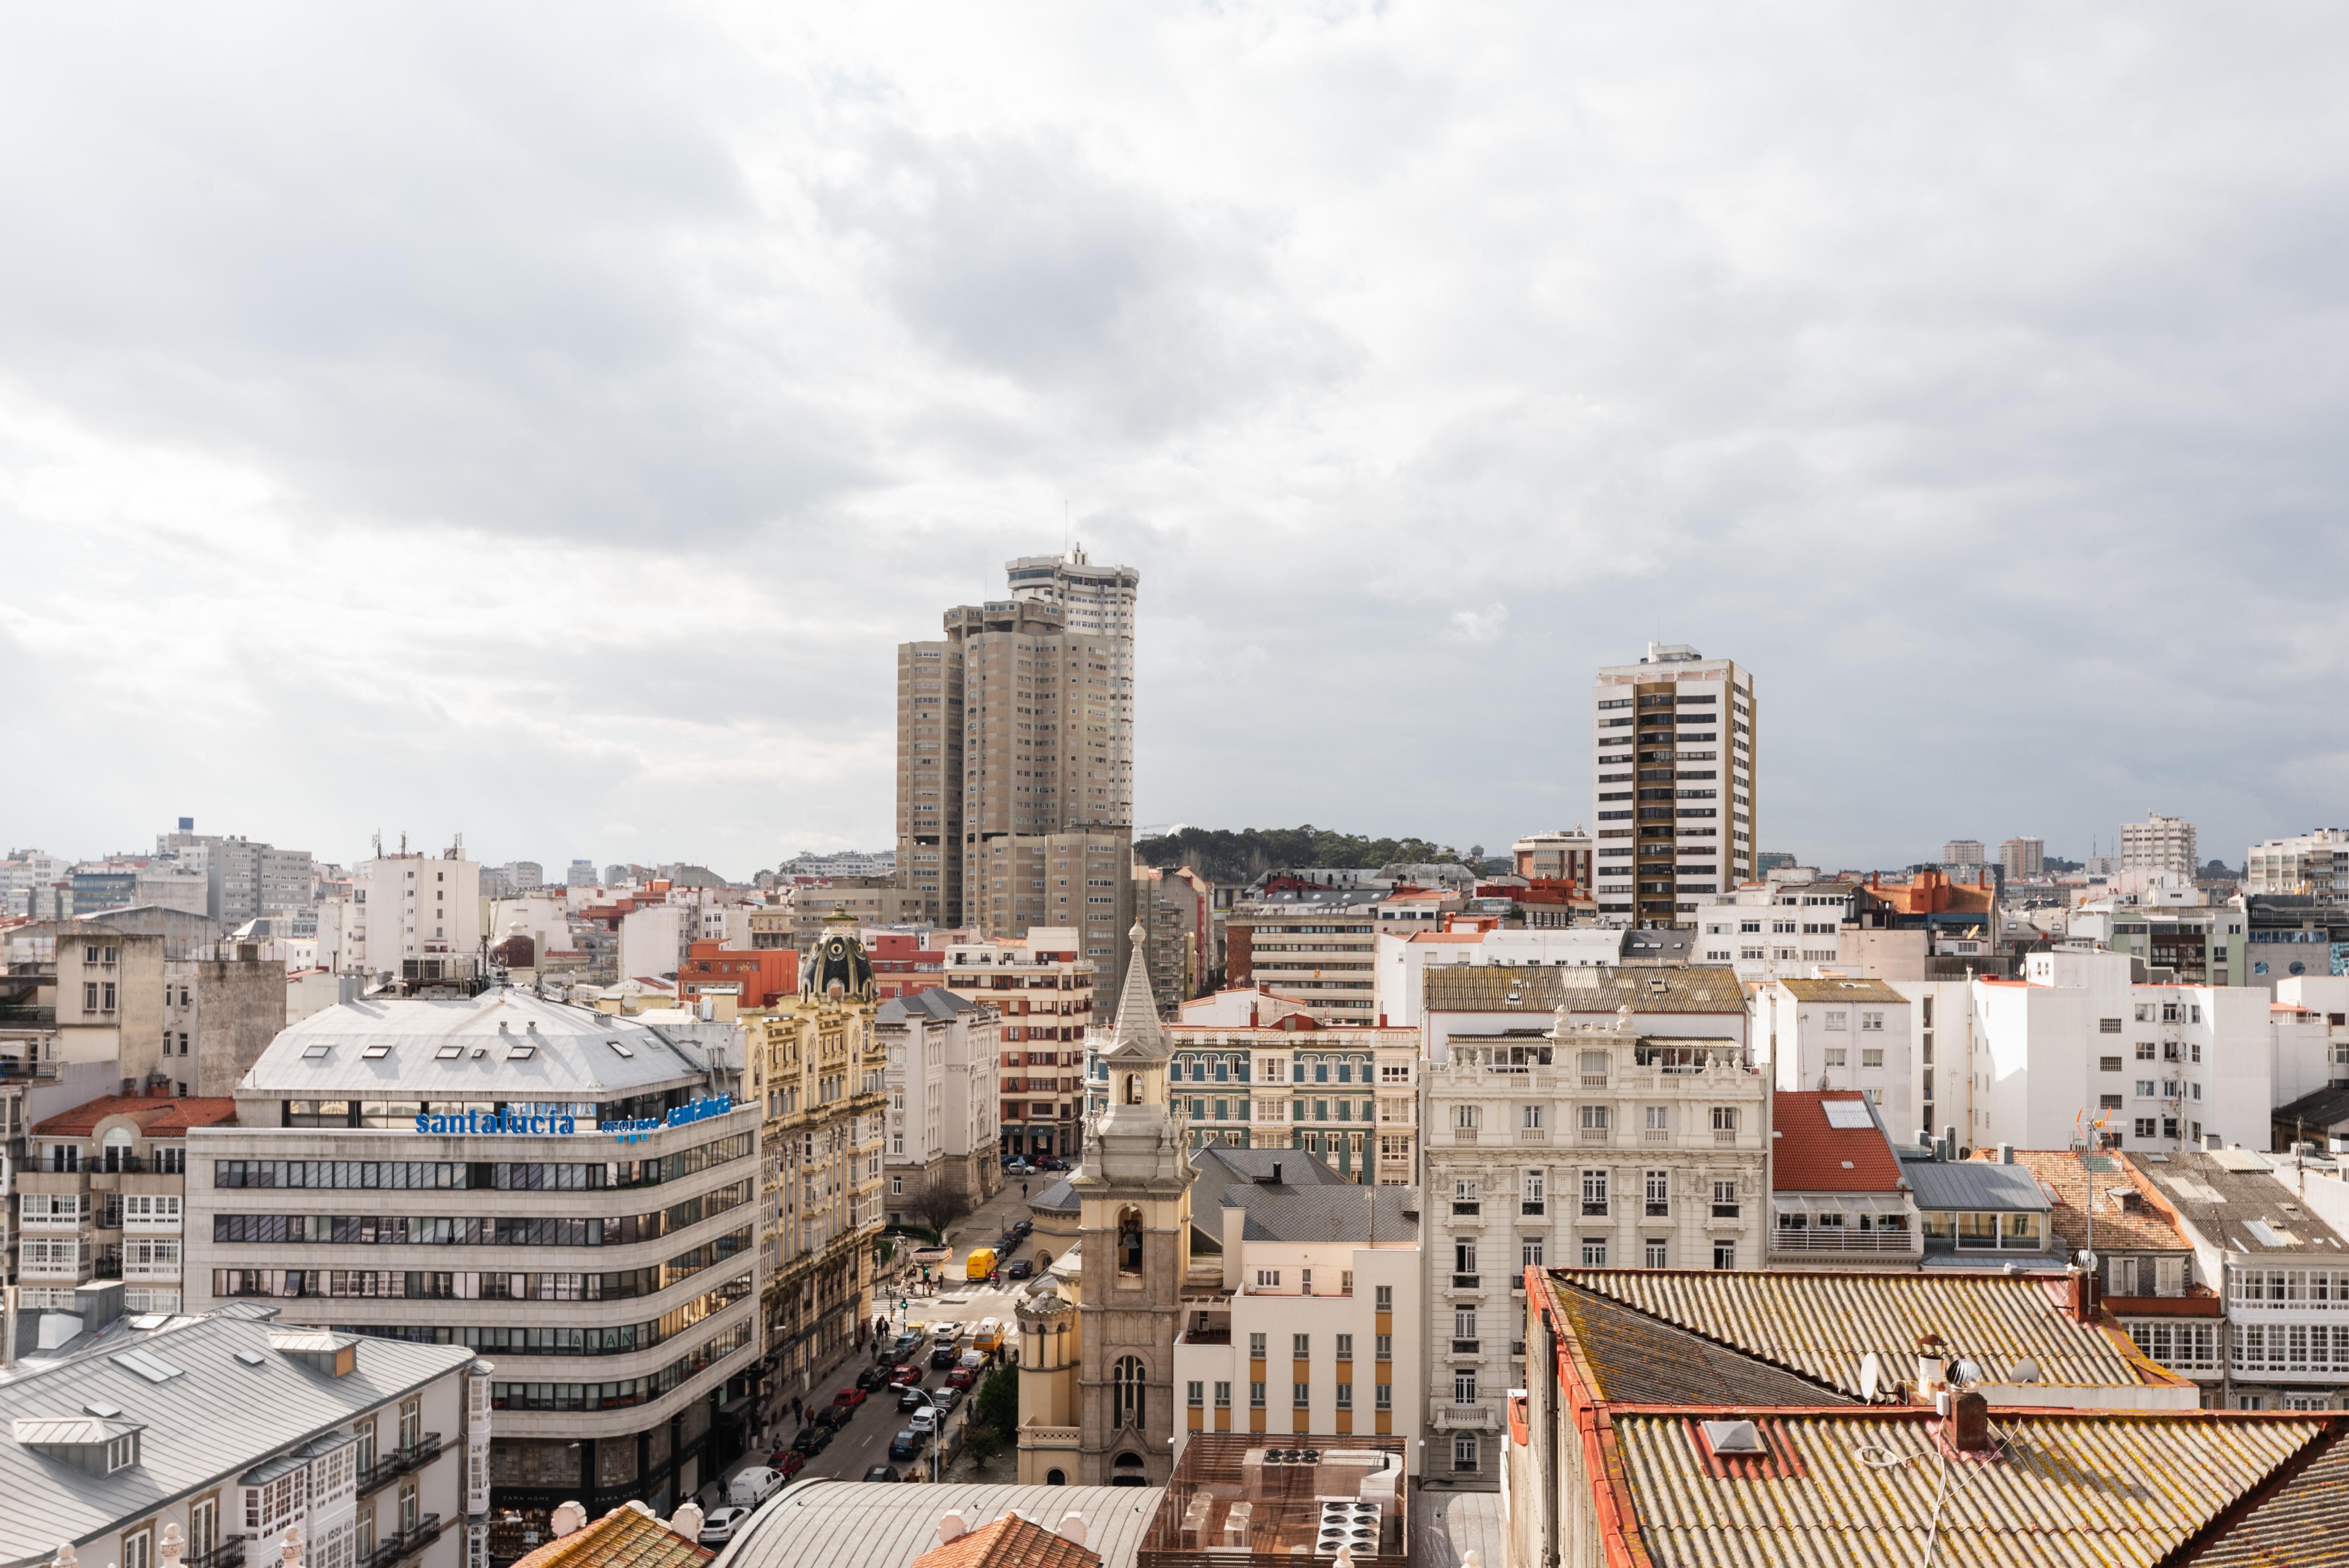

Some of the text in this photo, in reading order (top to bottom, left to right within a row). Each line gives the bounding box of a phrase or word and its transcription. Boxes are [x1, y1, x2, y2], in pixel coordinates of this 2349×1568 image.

[415, 1108, 575, 1134] santalucía
[602, 1117, 660, 1133] SEGUROS
[622, 1488, 641, 1498] HOME
